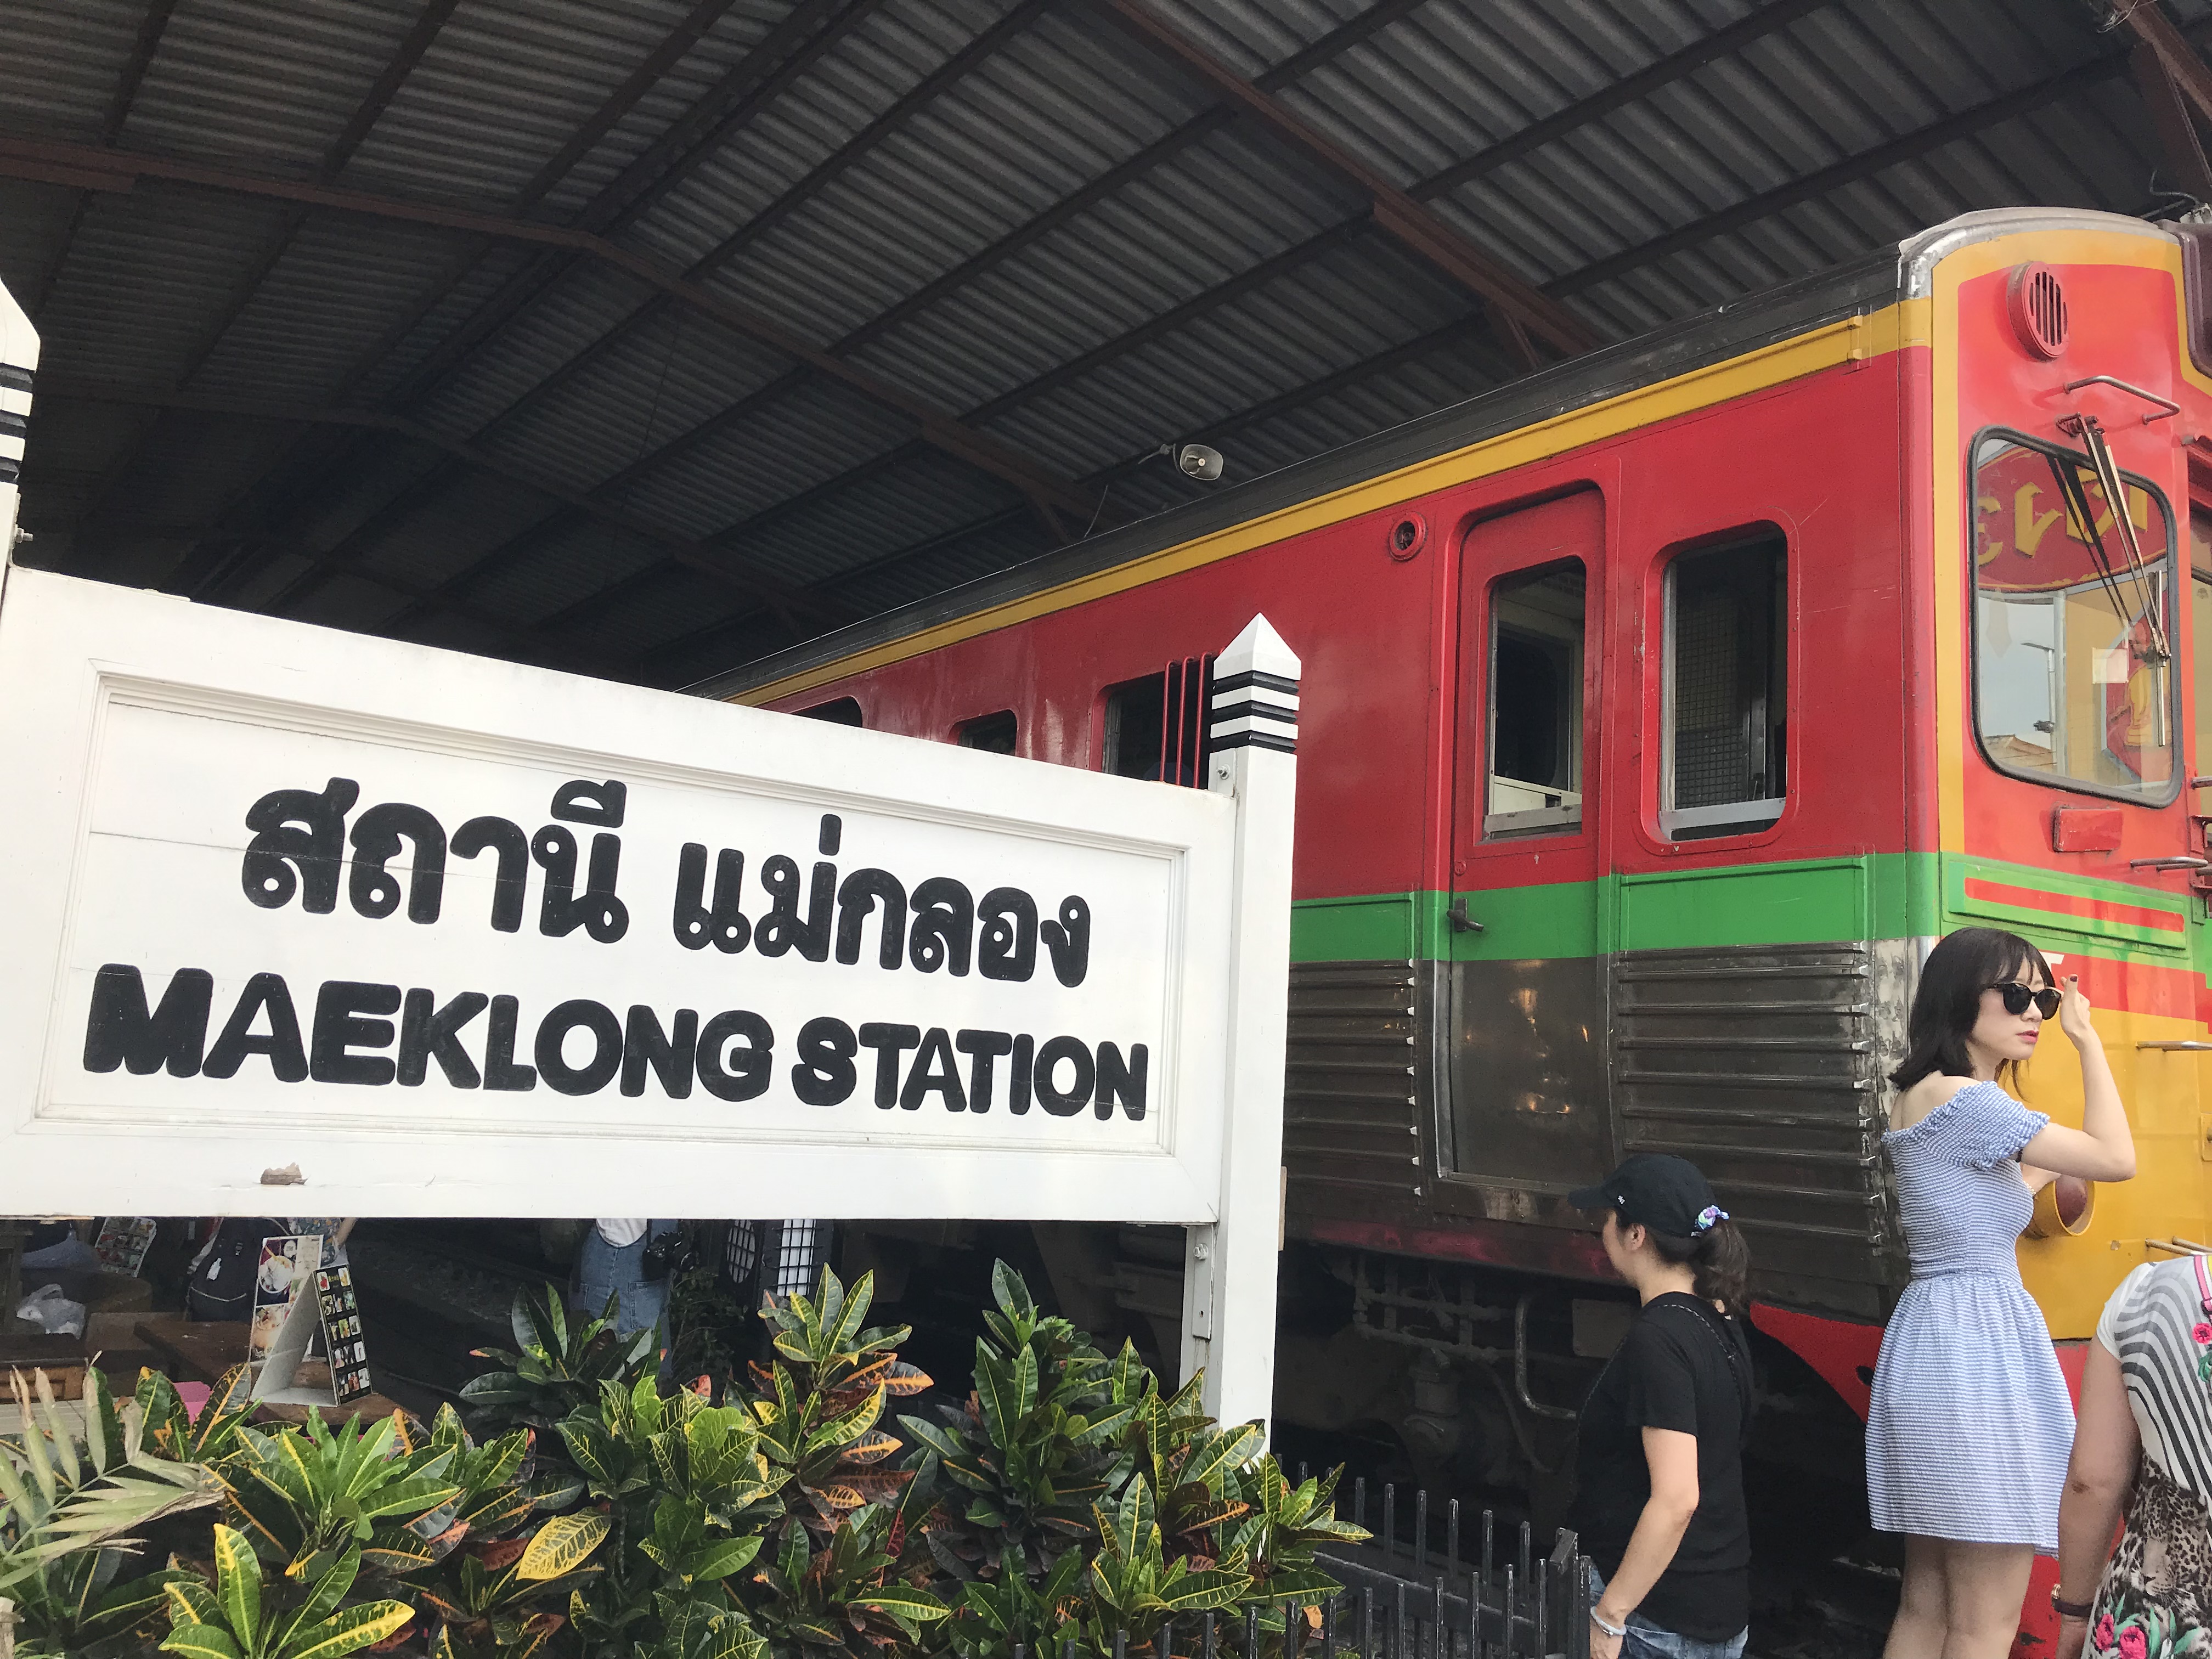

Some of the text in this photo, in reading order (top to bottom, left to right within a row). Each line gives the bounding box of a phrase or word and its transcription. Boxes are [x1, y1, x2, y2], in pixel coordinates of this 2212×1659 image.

[241, 777, 1091, 989] สถานี แม่กลอง
[82, 963, 1149, 1121] MAEKLONG STATION
